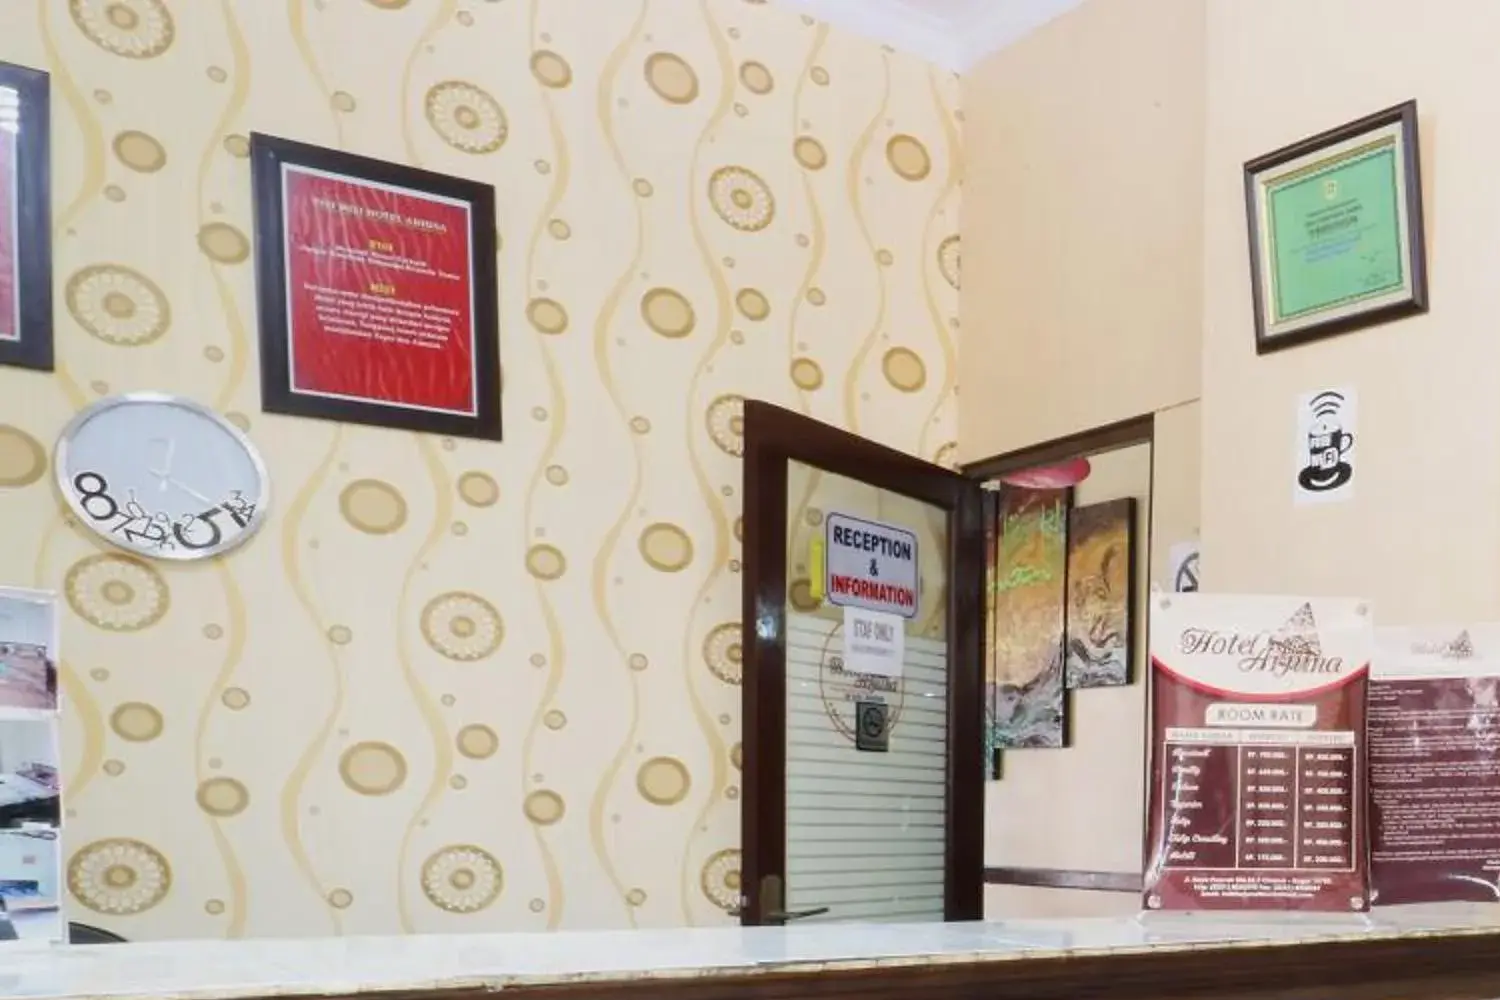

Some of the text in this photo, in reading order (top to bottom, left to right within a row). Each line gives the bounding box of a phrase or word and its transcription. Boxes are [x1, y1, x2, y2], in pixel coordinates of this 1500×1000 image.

[74, 471, 118, 521] 8
[173, 507, 222, 549] 5
[833, 525, 911, 561] RECEPTION
[869, 558, 879, 577] &
[830, 573, 914, 607] INFORMATION
[1180, 626, 1344, 678] Hotel Arjuna
[1217, 709, 1303, 722] ROOM RATE
